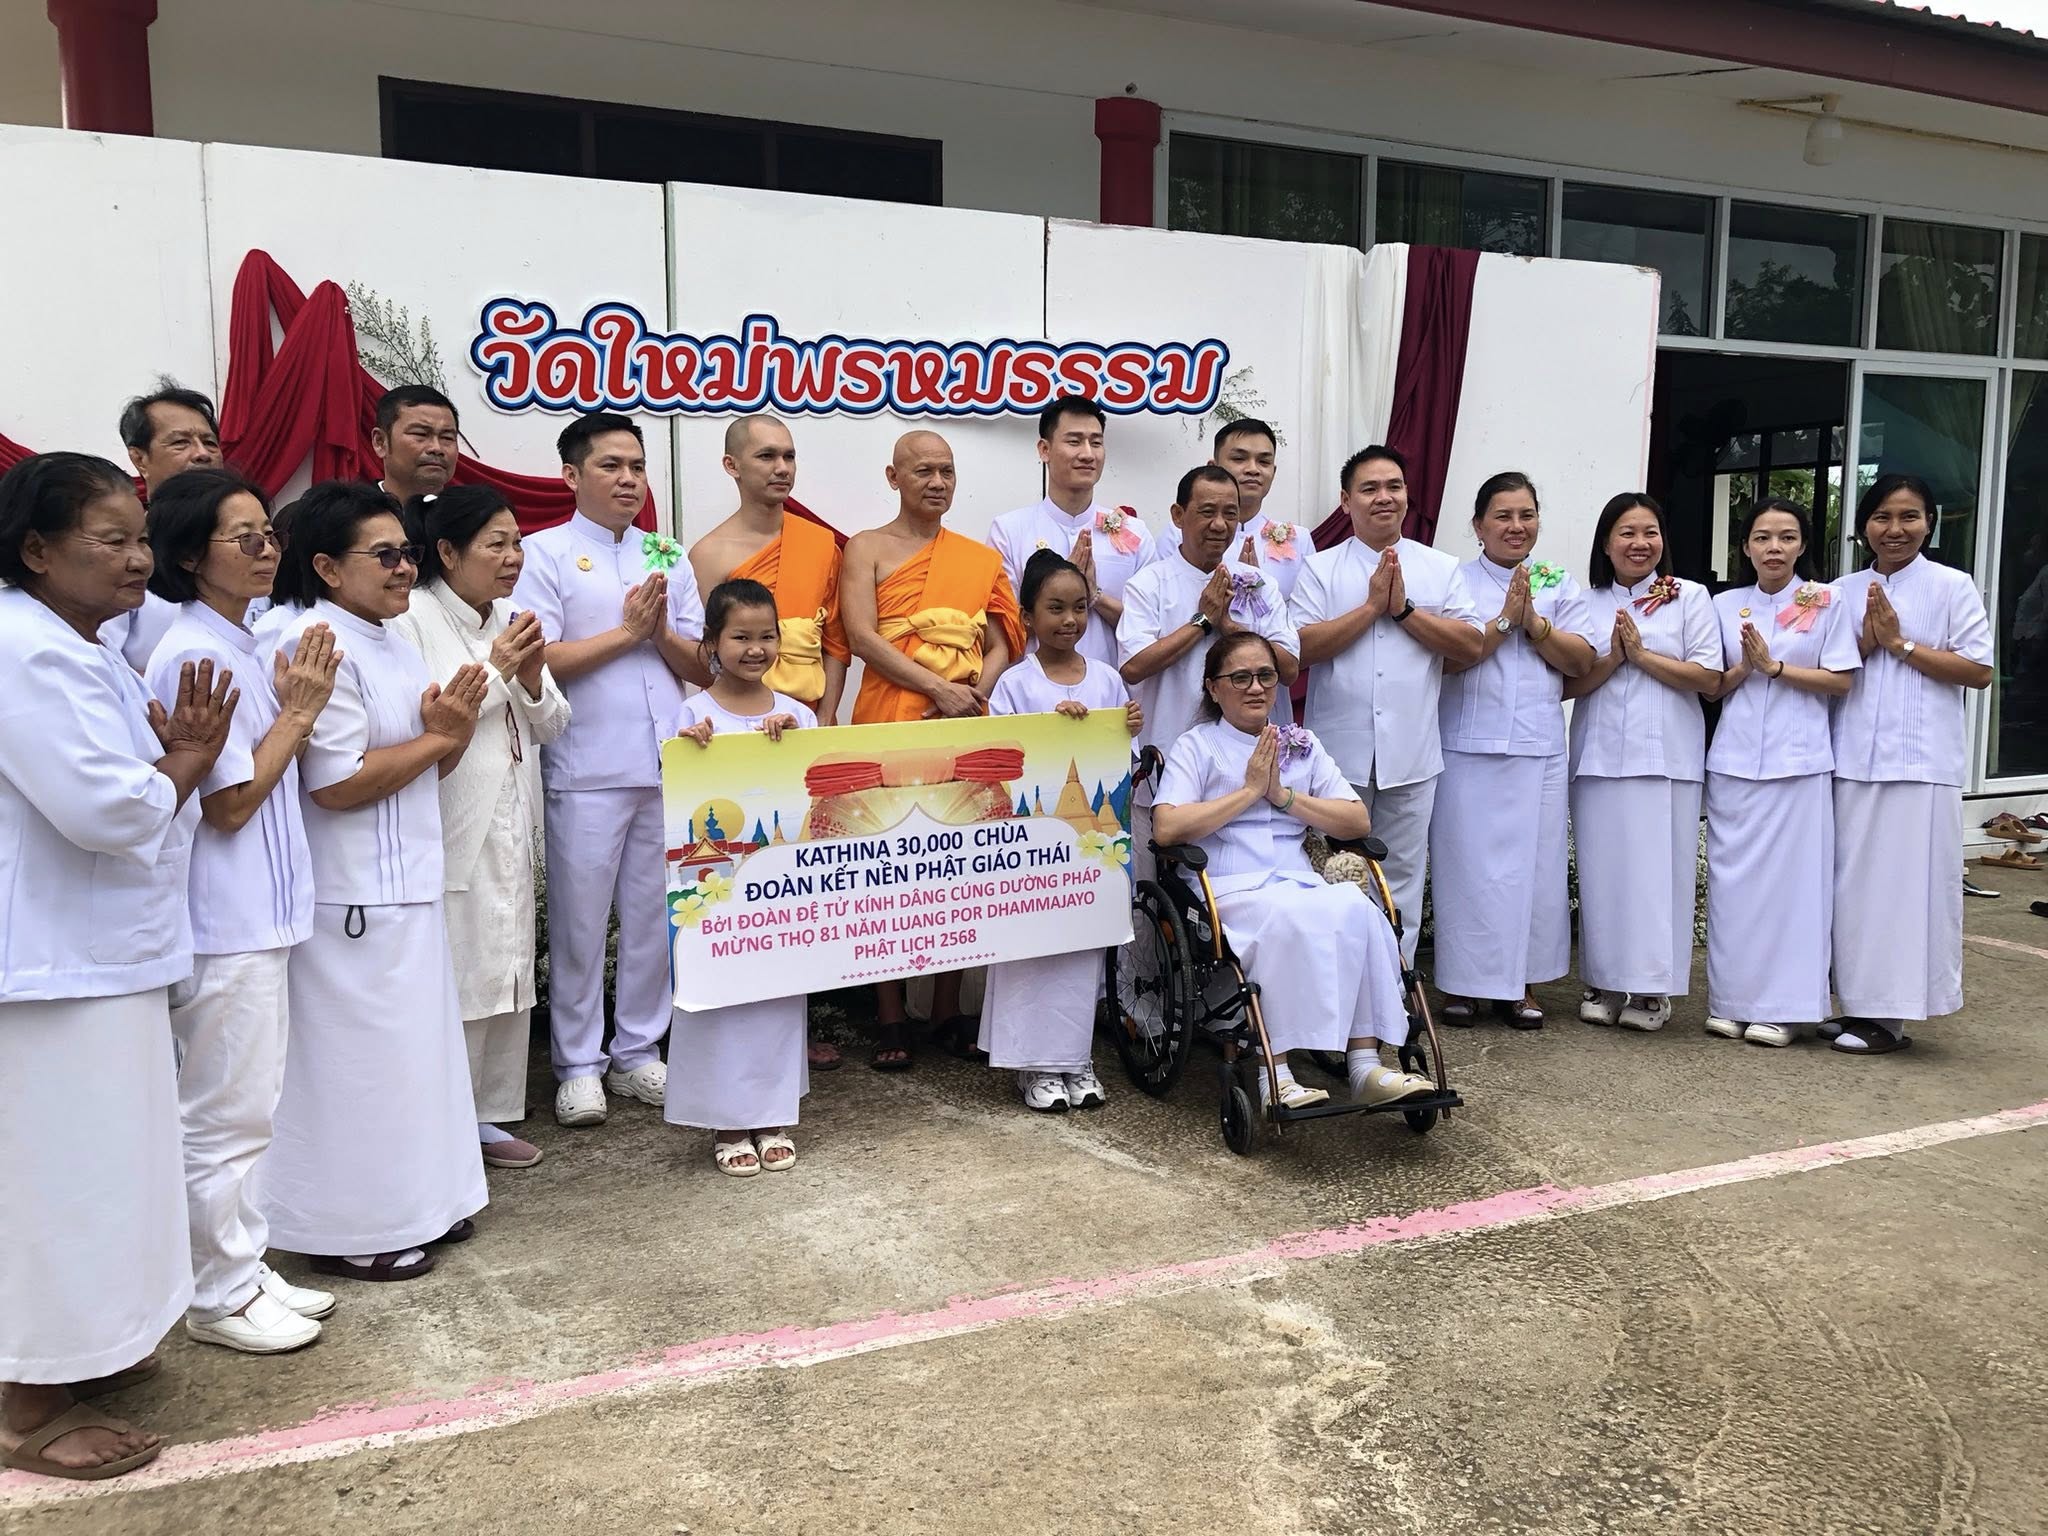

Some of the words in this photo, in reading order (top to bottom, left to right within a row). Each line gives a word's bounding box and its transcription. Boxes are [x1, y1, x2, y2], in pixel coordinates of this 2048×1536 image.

[478, 306, 1222, 403] วัดใหม่พรหมธรรม
[744, 873, 813, 902] ĐOÀN
[820, 865, 859, 892] KẾT
[865, 859, 909, 887] NỀN
[915, 854, 967, 881] PHẬT
[972, 847, 1021, 874] GIÁO
[1026, 841, 1071, 867] THÁI
[796, 839, 891, 868] KATHINA
[896, 831, 963, 857] 30,000
[973, 821, 1029, 847] CHÙA
[711, 935, 773, 958] MỪNG
[778, 929, 815, 948] THỌ
[820, 925, 840, 943] 81
[845, 917, 887, 939] NĂM
[892, 910, 946, 932] LUANG
[951, 905, 983, 924] POR
[987, 890, 1096, 919] DHAMMAJAYO
[737, 907, 791, 930] ĐOÀN
[795, 901, 819, 923] ĐỆ
[823, 896, 850, 918] TỬ
[854, 895, 895, 915] KÍNH
[899, 887, 946, 909] DÂNG
[950, 881, 995, 902] CÚNG
[999, 873, 1058, 895] DƯỜNG
[1062, 866, 1102, 887] PHÁP
[854, 938, 897, 961] PHẬT
[901, 934, 935, 955] LỊCH
[940, 928, 977, 947] 2568
